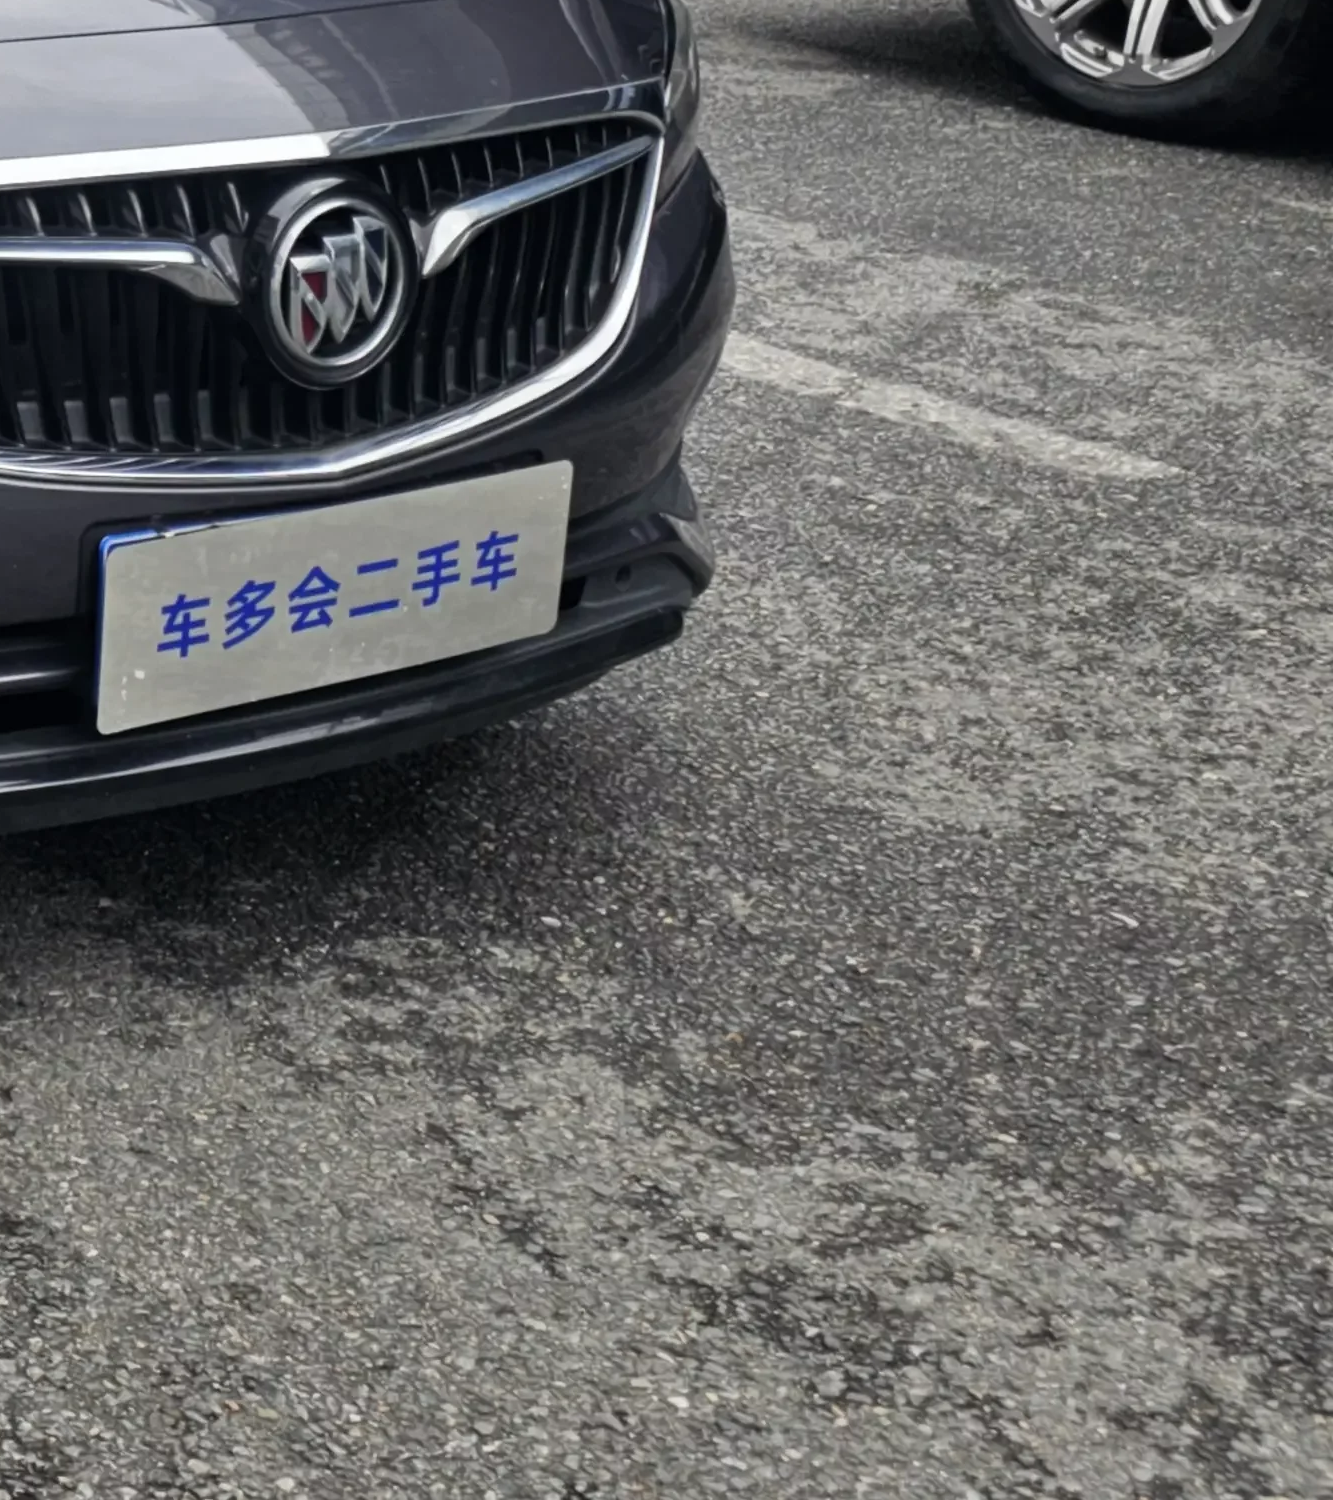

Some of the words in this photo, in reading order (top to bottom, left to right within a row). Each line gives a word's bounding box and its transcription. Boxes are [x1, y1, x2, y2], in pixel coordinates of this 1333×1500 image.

[156, 530, 521, 659] 车多会二手车
